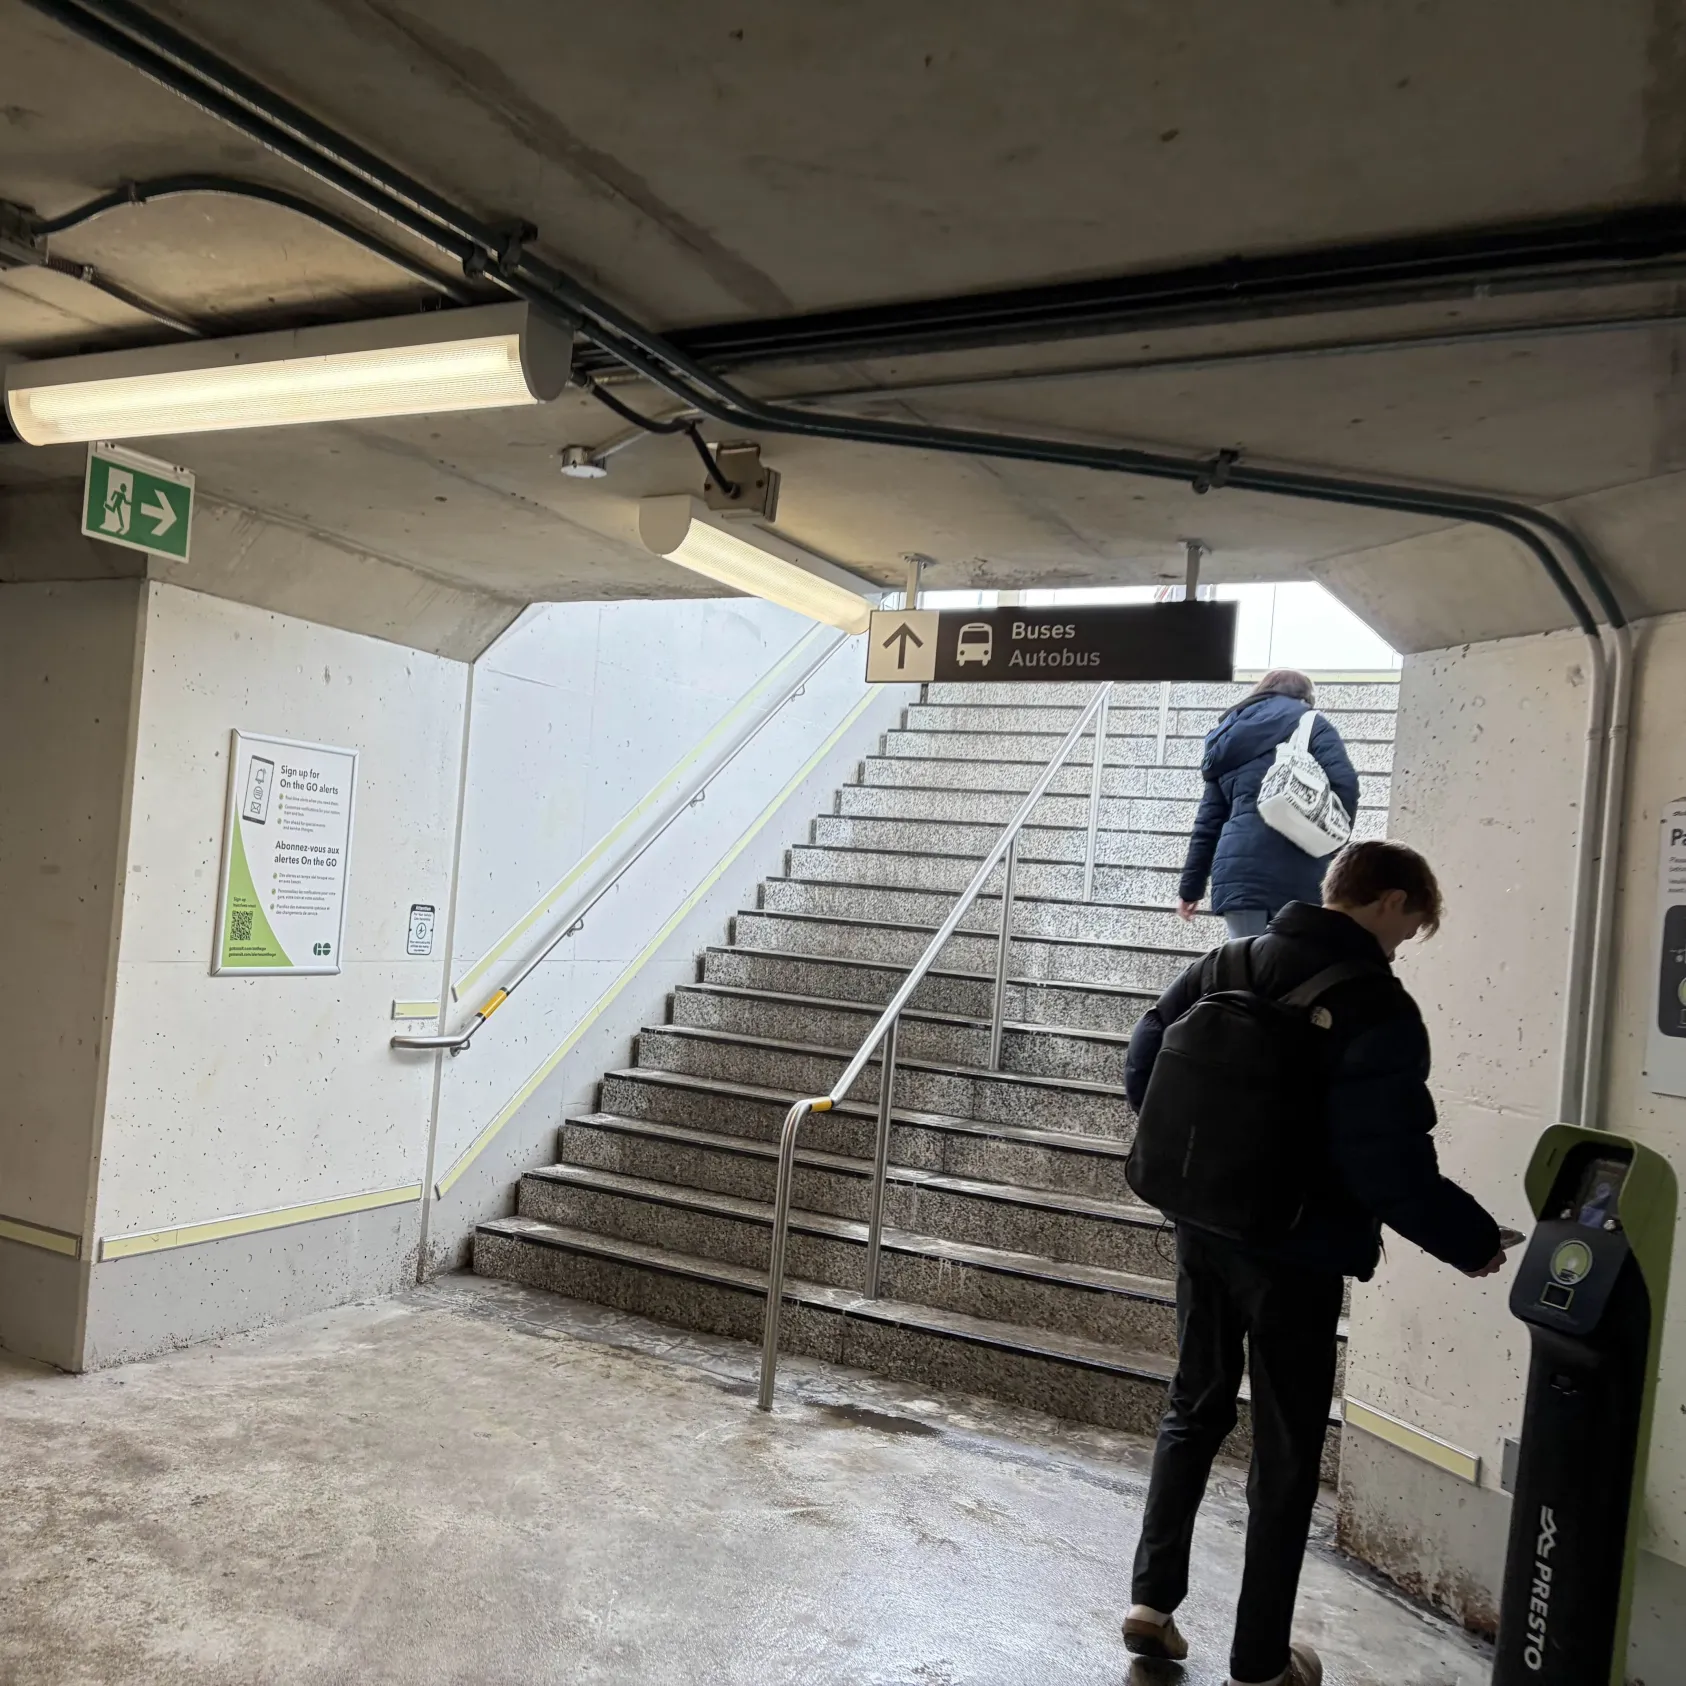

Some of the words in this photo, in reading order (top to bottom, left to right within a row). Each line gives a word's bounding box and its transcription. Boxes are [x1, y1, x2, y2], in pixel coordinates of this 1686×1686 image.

[1011, 621, 1076, 640] Buses
[1008, 648, 1101, 667] Autobus
[281, 764, 297, 778] Sign
[298, 769, 308, 780] up
[309, 768, 320, 779] for
[280, 778, 291, 788] On
[293, 780, 305, 791] the
[306, 782, 318, 792] GO
[319, 784, 339, 795] alerts
[275, 840, 326, 853] Abonnez-vous
[327, 847, 340, 855] aux
[274, 853, 300, 865] alertes
[301, 856, 312, 866] On
[313, 856, 325, 867] the
[325, 858, 338, 867] GO
[1523, 1560, 1553, 1671] PRESTO
